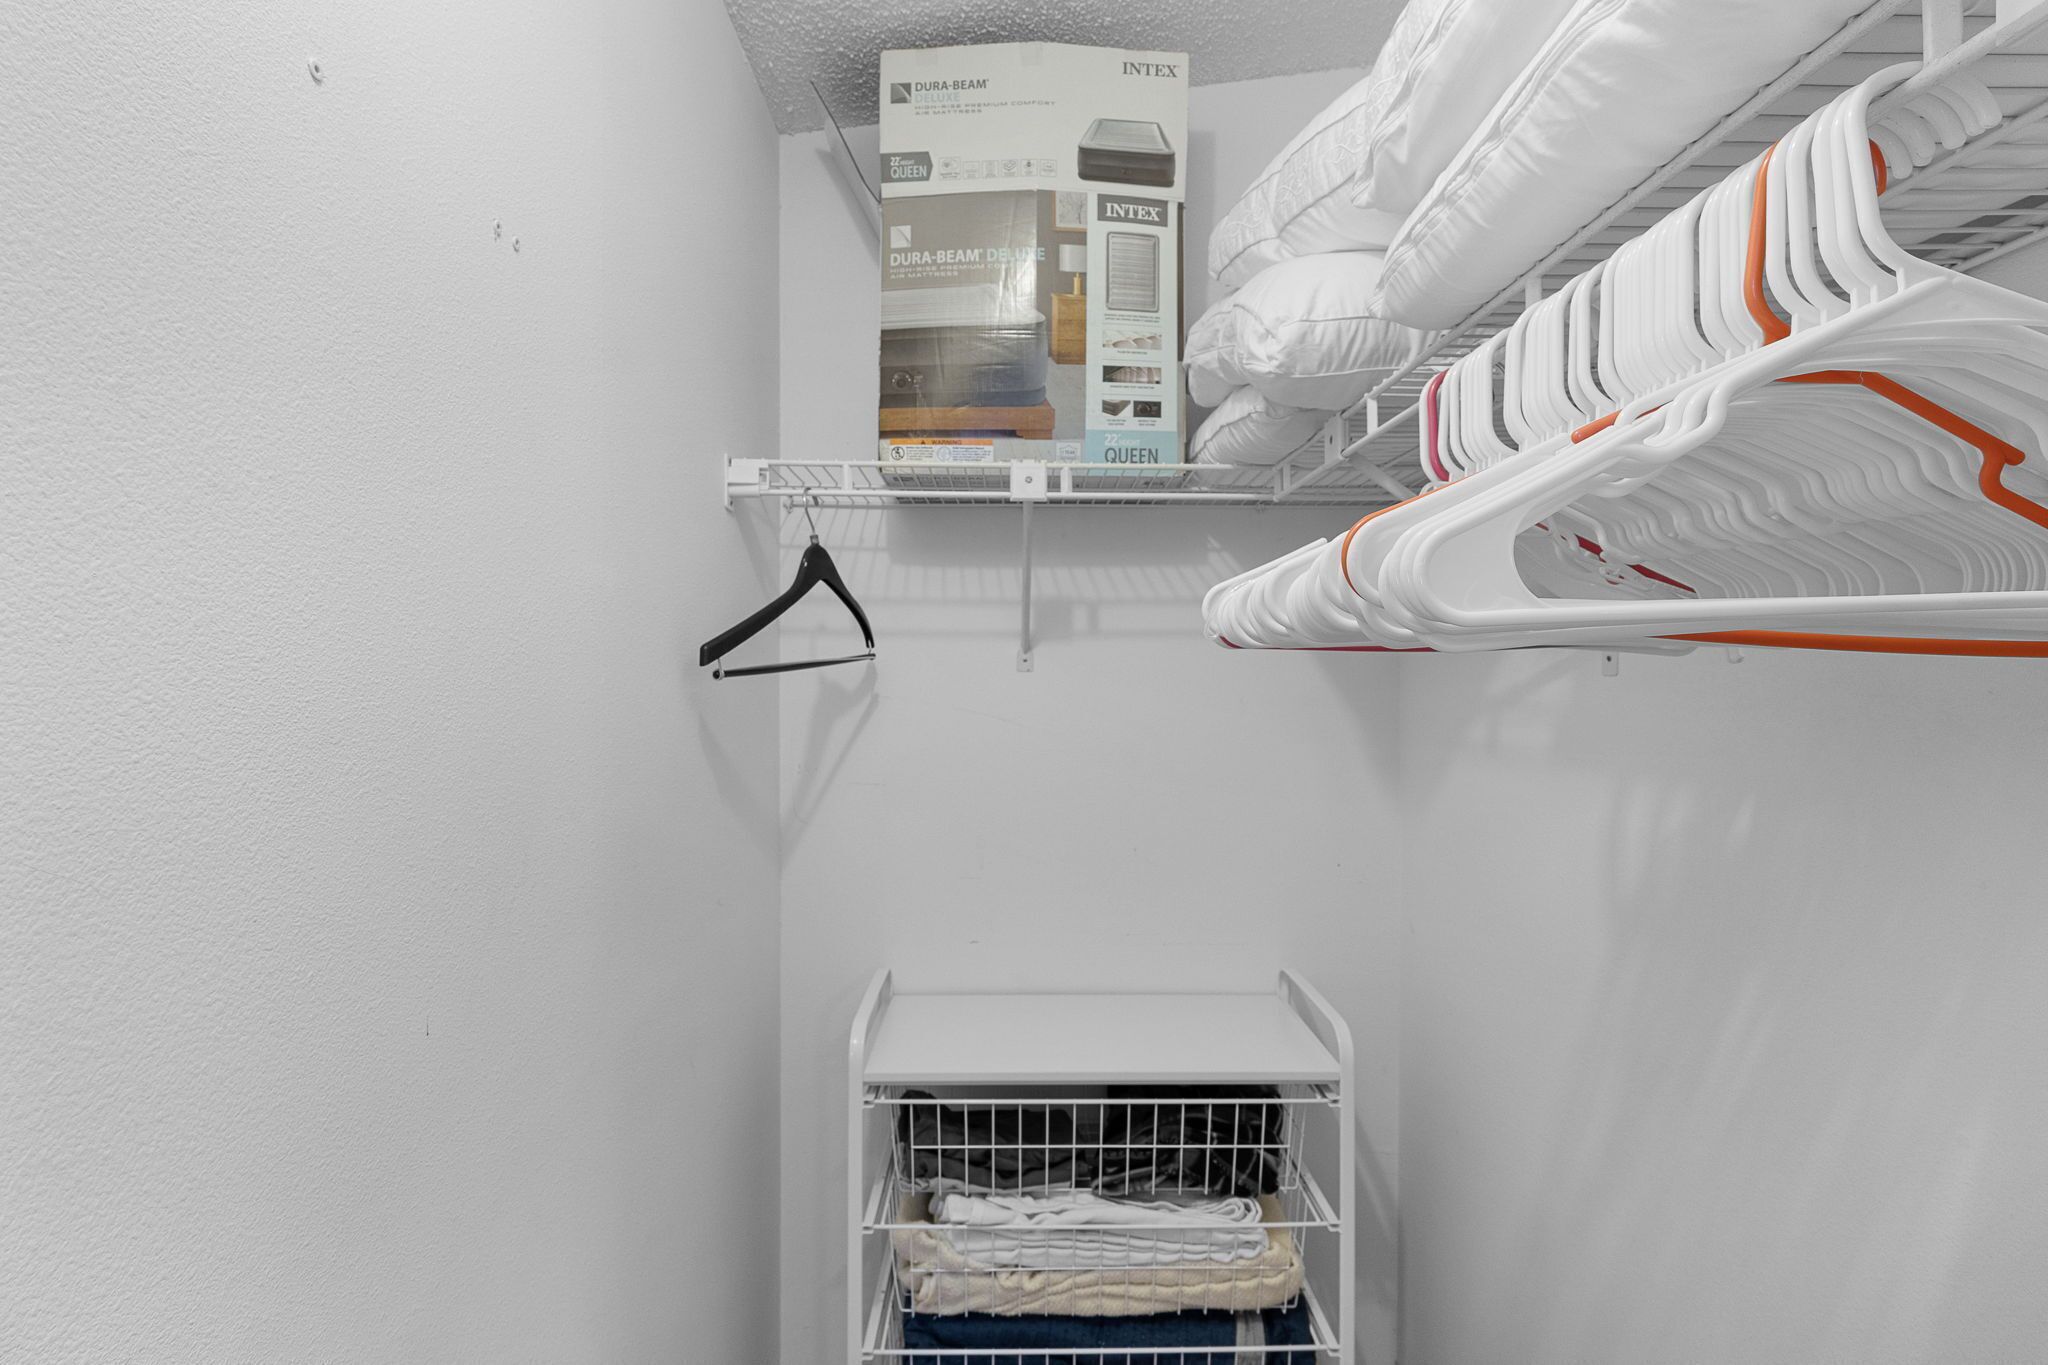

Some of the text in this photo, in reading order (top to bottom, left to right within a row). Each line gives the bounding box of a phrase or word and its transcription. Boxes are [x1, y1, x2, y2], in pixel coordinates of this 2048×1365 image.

[1122, 62, 1177, 78] INTEX
[914, 92, 961, 103] DELUXE
[964, 101, 1008, 109] PREMIUM
[890, 165, 928, 179] QUEEN
[1105, 203, 1160, 221] INTEX
[1104, 447, 1159, 464] QUEEN
